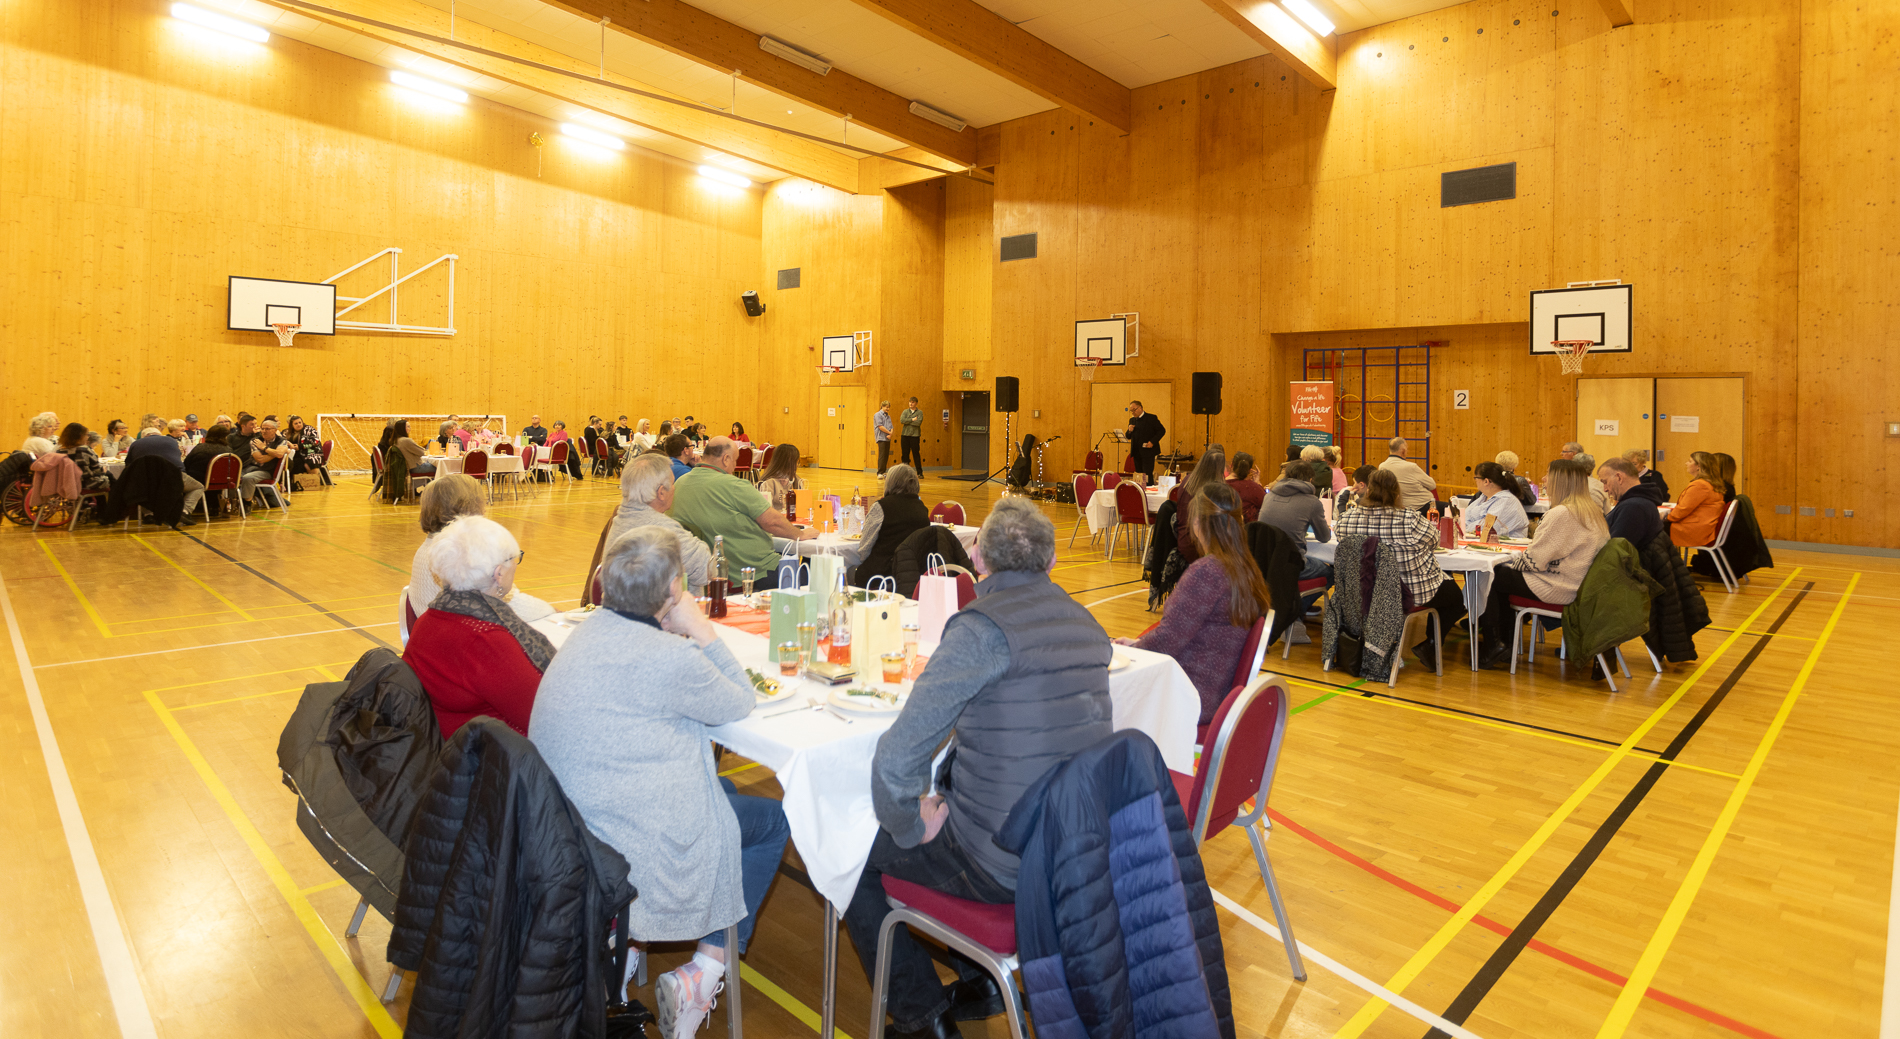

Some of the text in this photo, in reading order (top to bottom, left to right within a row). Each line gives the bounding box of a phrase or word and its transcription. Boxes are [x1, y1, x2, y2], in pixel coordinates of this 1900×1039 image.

[1457, 392, 1466, 406] 2
[1291, 401, 1331, 414] Volunteer
[1300, 414, 1322, 423] for Fife
